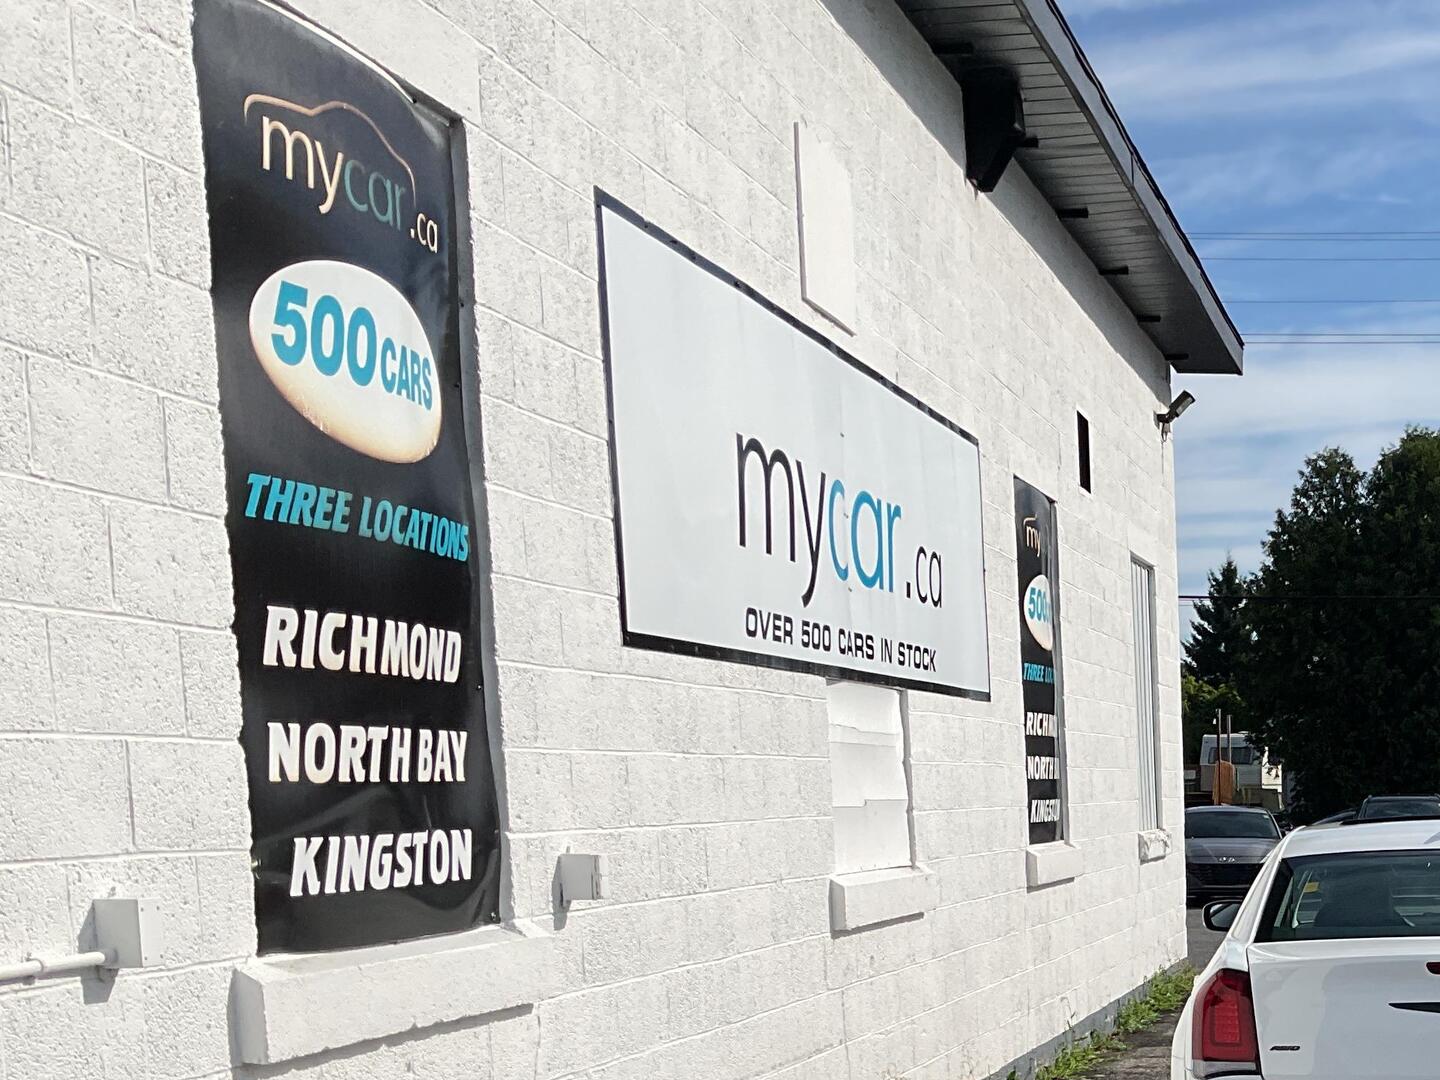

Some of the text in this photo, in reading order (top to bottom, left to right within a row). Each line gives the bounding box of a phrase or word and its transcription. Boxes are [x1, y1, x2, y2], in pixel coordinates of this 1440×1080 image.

[271, 280, 433, 410] 500 CARS
[244, 472, 469, 562] THREE LOCATIONS
[263, 605, 461, 684] RICHMOND
[745, 607, 937, 673] OVER 500 CARS IN STOCK
[1023, 663, 1045, 682] THREE
[267, 721, 468, 784] NORTH BAY
[1026, 711, 1057, 737] RICH
[289, 828, 472, 897] KINGSTON
